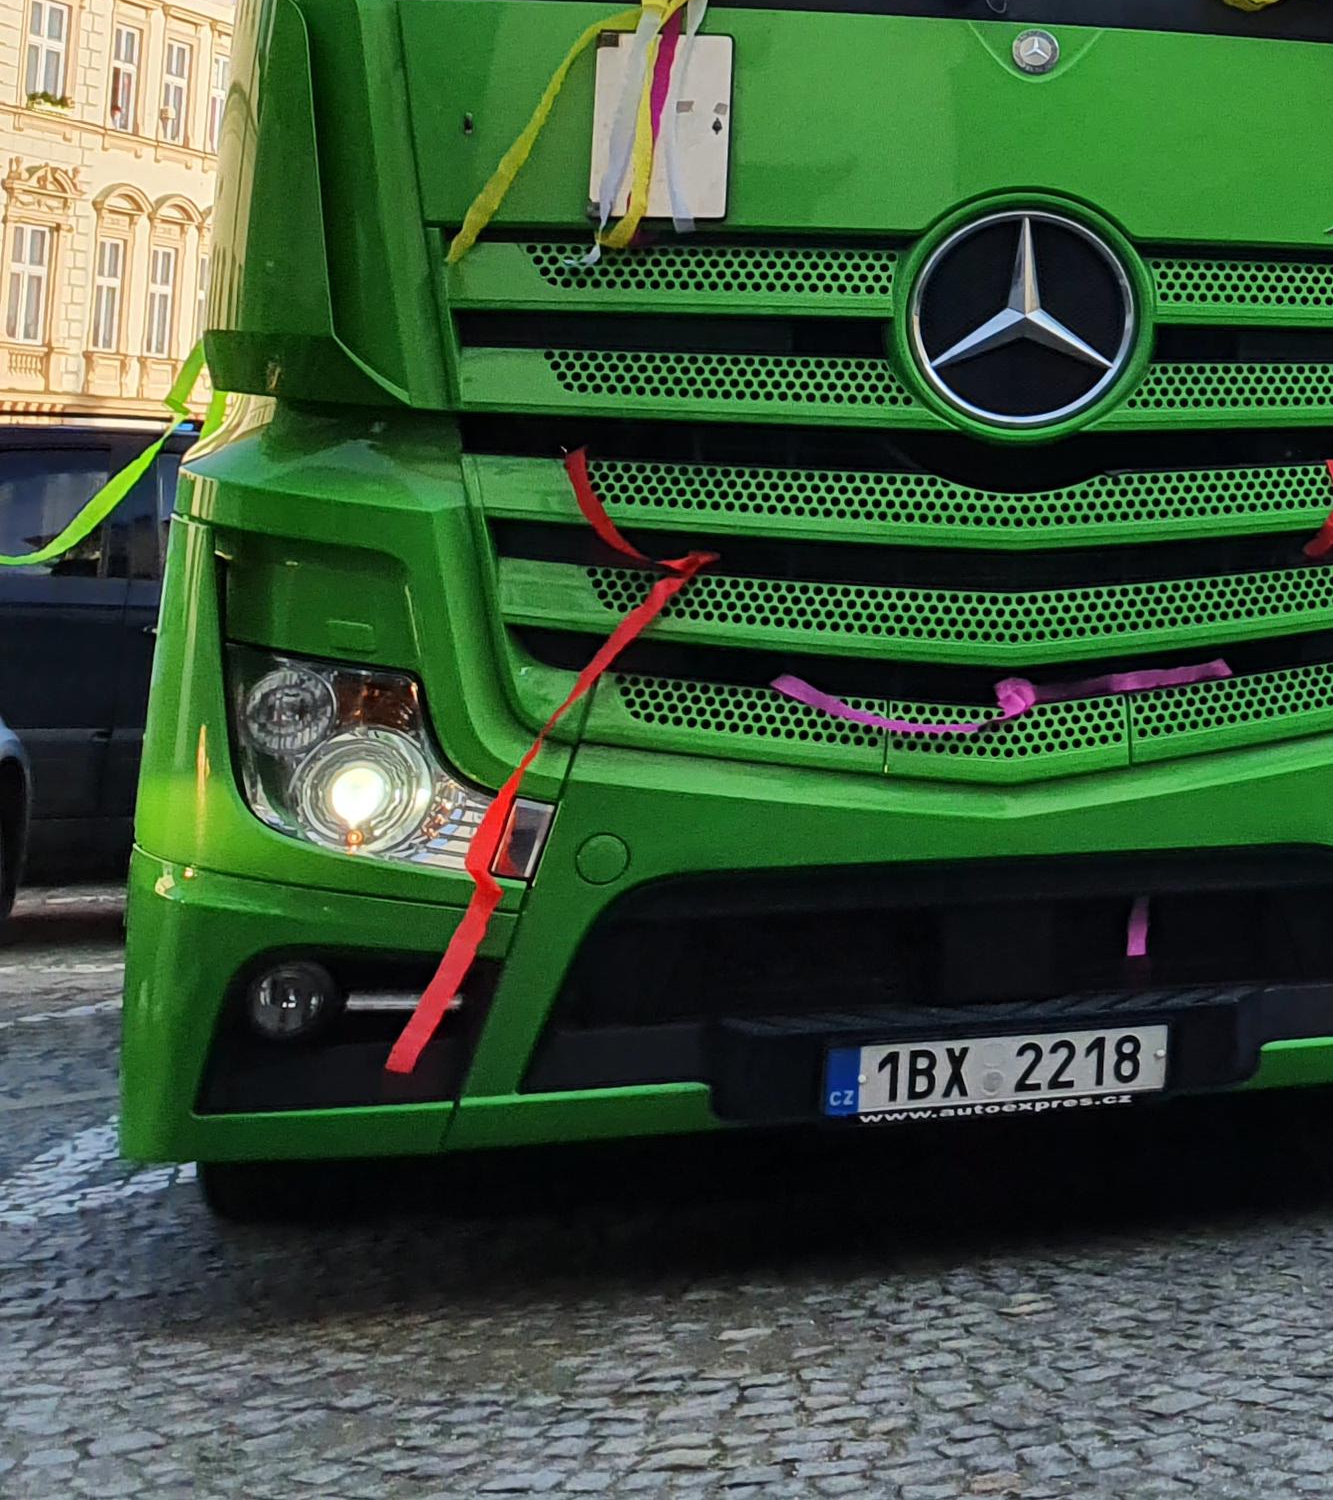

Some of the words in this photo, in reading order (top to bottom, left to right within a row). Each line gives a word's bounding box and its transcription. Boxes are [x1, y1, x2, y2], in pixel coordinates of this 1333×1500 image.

[829, 1090, 855, 1107] CZ
[877, 1046, 970, 1102] 1BX
[1014, 1034, 1142, 1093] 2218
[859, 1093, 1132, 1124] www.autoexpres.cz
